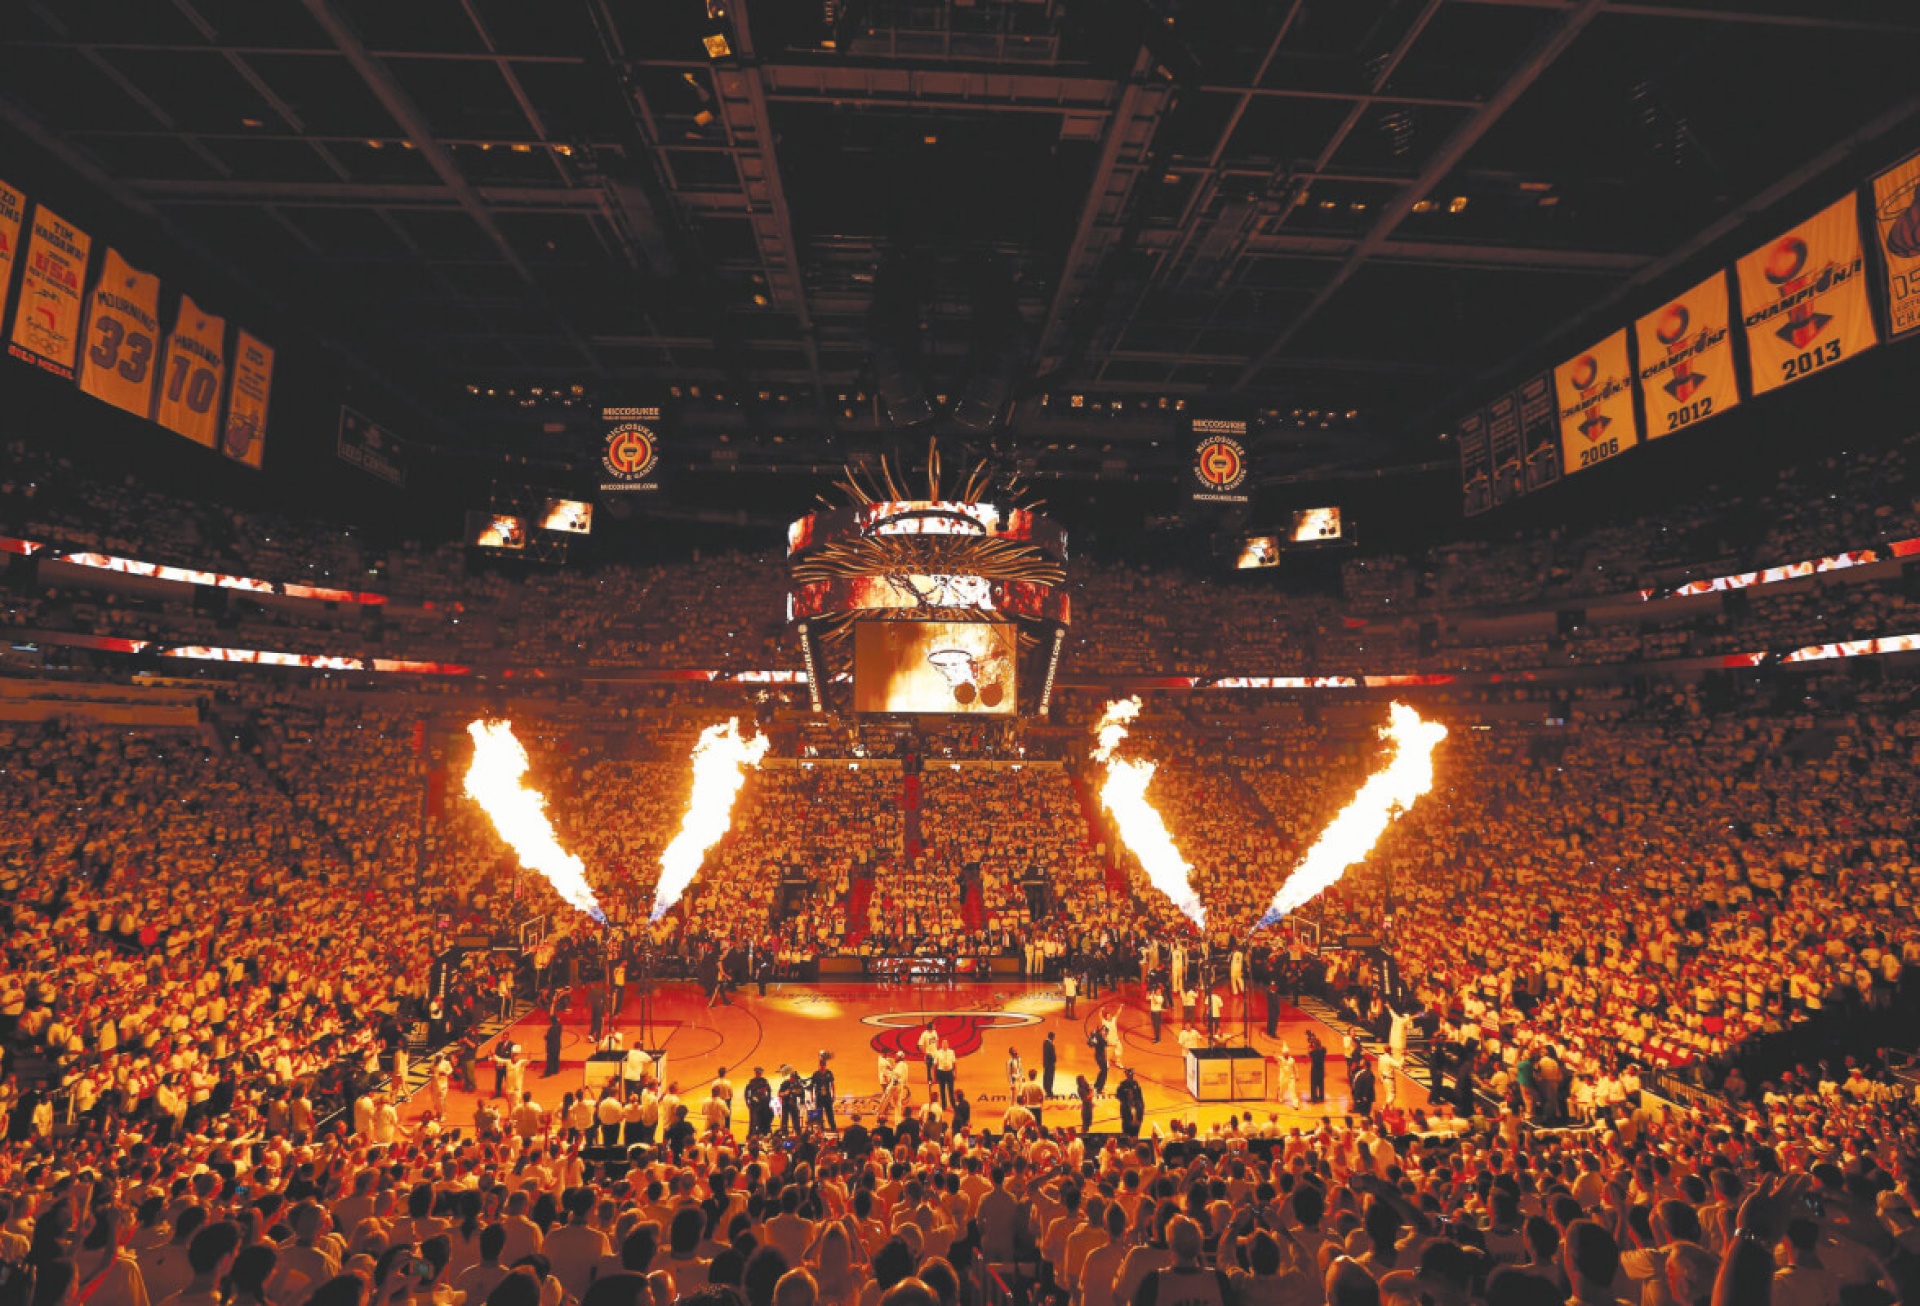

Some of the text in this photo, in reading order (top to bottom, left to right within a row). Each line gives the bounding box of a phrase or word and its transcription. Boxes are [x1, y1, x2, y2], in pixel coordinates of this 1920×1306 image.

[53, 221, 73, 241] TIM
[36, 252, 77, 289] USA
[98, 291, 158, 333] MOURNING
[90, 315, 152, 383] 33
[1642, 328, 1726, 379] CHAMPIONS
[1782, 338, 1840, 381] 2013
[168, 355, 217, 414] 10
[603, 407, 659, 415] MICCOSUKEE
[1192, 420, 1246, 428] MICCOSUKEE
[1668, 397, 1712, 431] 2012
[605, 423, 657, 443] MICCOSUKEE
[1197, 435, 1245, 456] MICCOSUKEE
[1580, 438, 1618, 467] 2006
